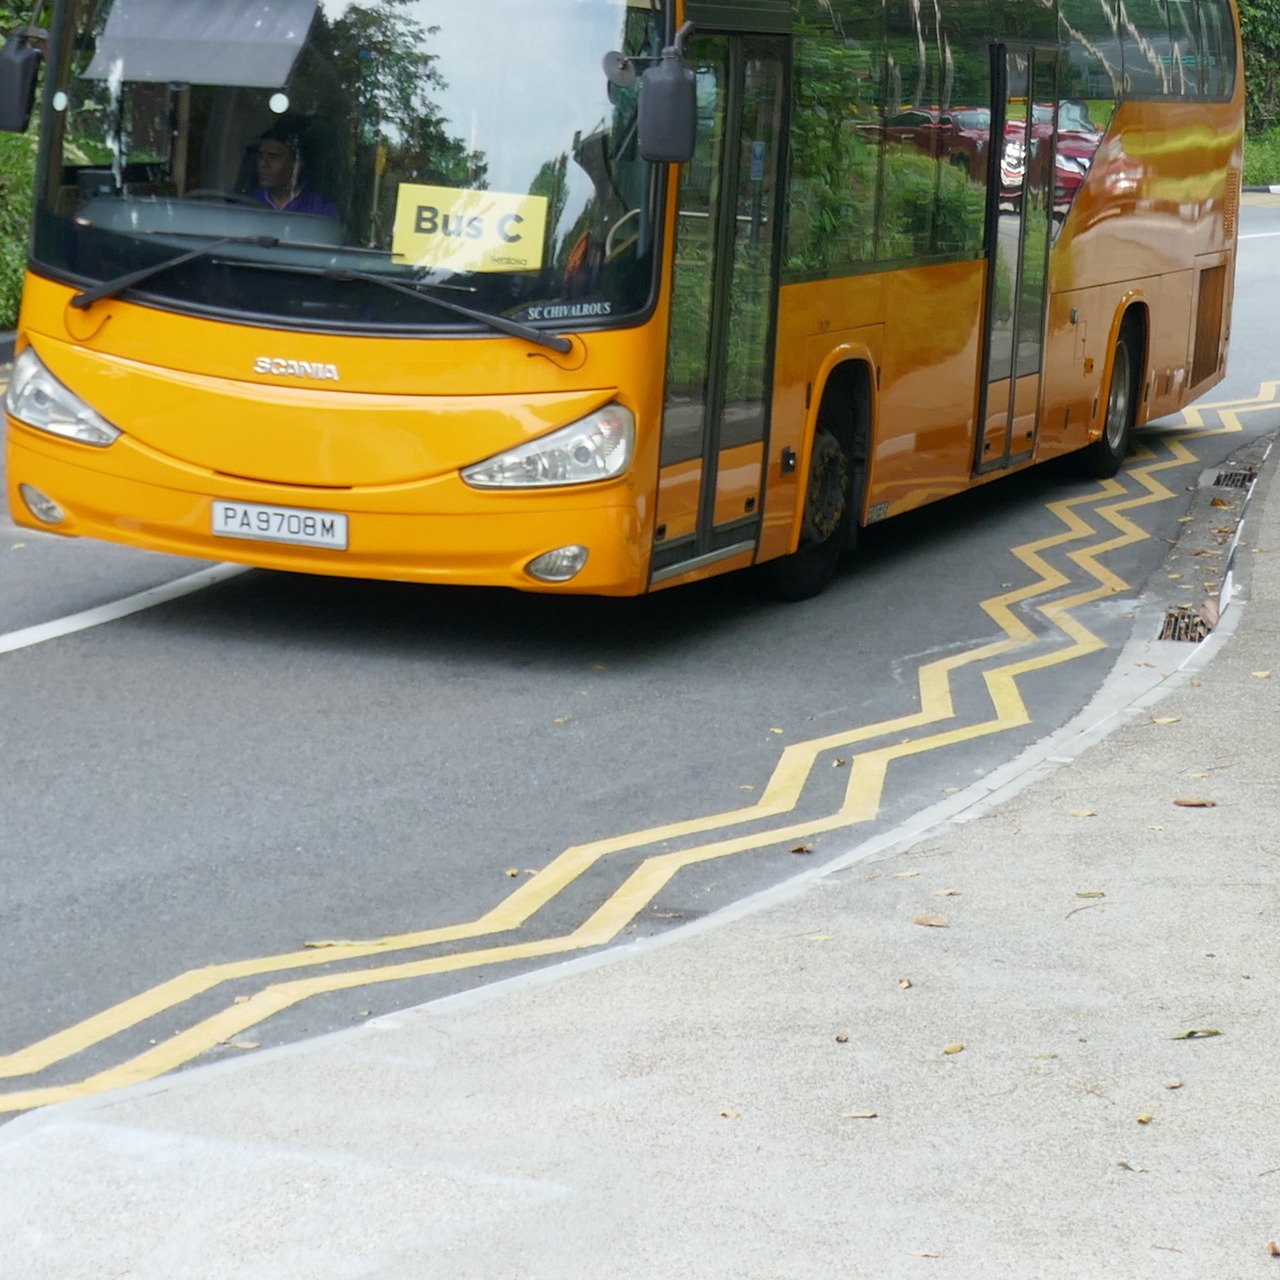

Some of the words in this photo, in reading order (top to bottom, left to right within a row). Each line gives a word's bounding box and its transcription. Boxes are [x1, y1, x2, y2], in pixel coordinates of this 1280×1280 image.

[413, 205, 484, 239] Bus
[497, 214, 524, 243] C
[527, 307, 542, 320] SC
[543, 302, 611, 318] CHIVALROUS
[253, 356, 340, 382] SCANIA
[223, 507, 336, 539] PA9708M
